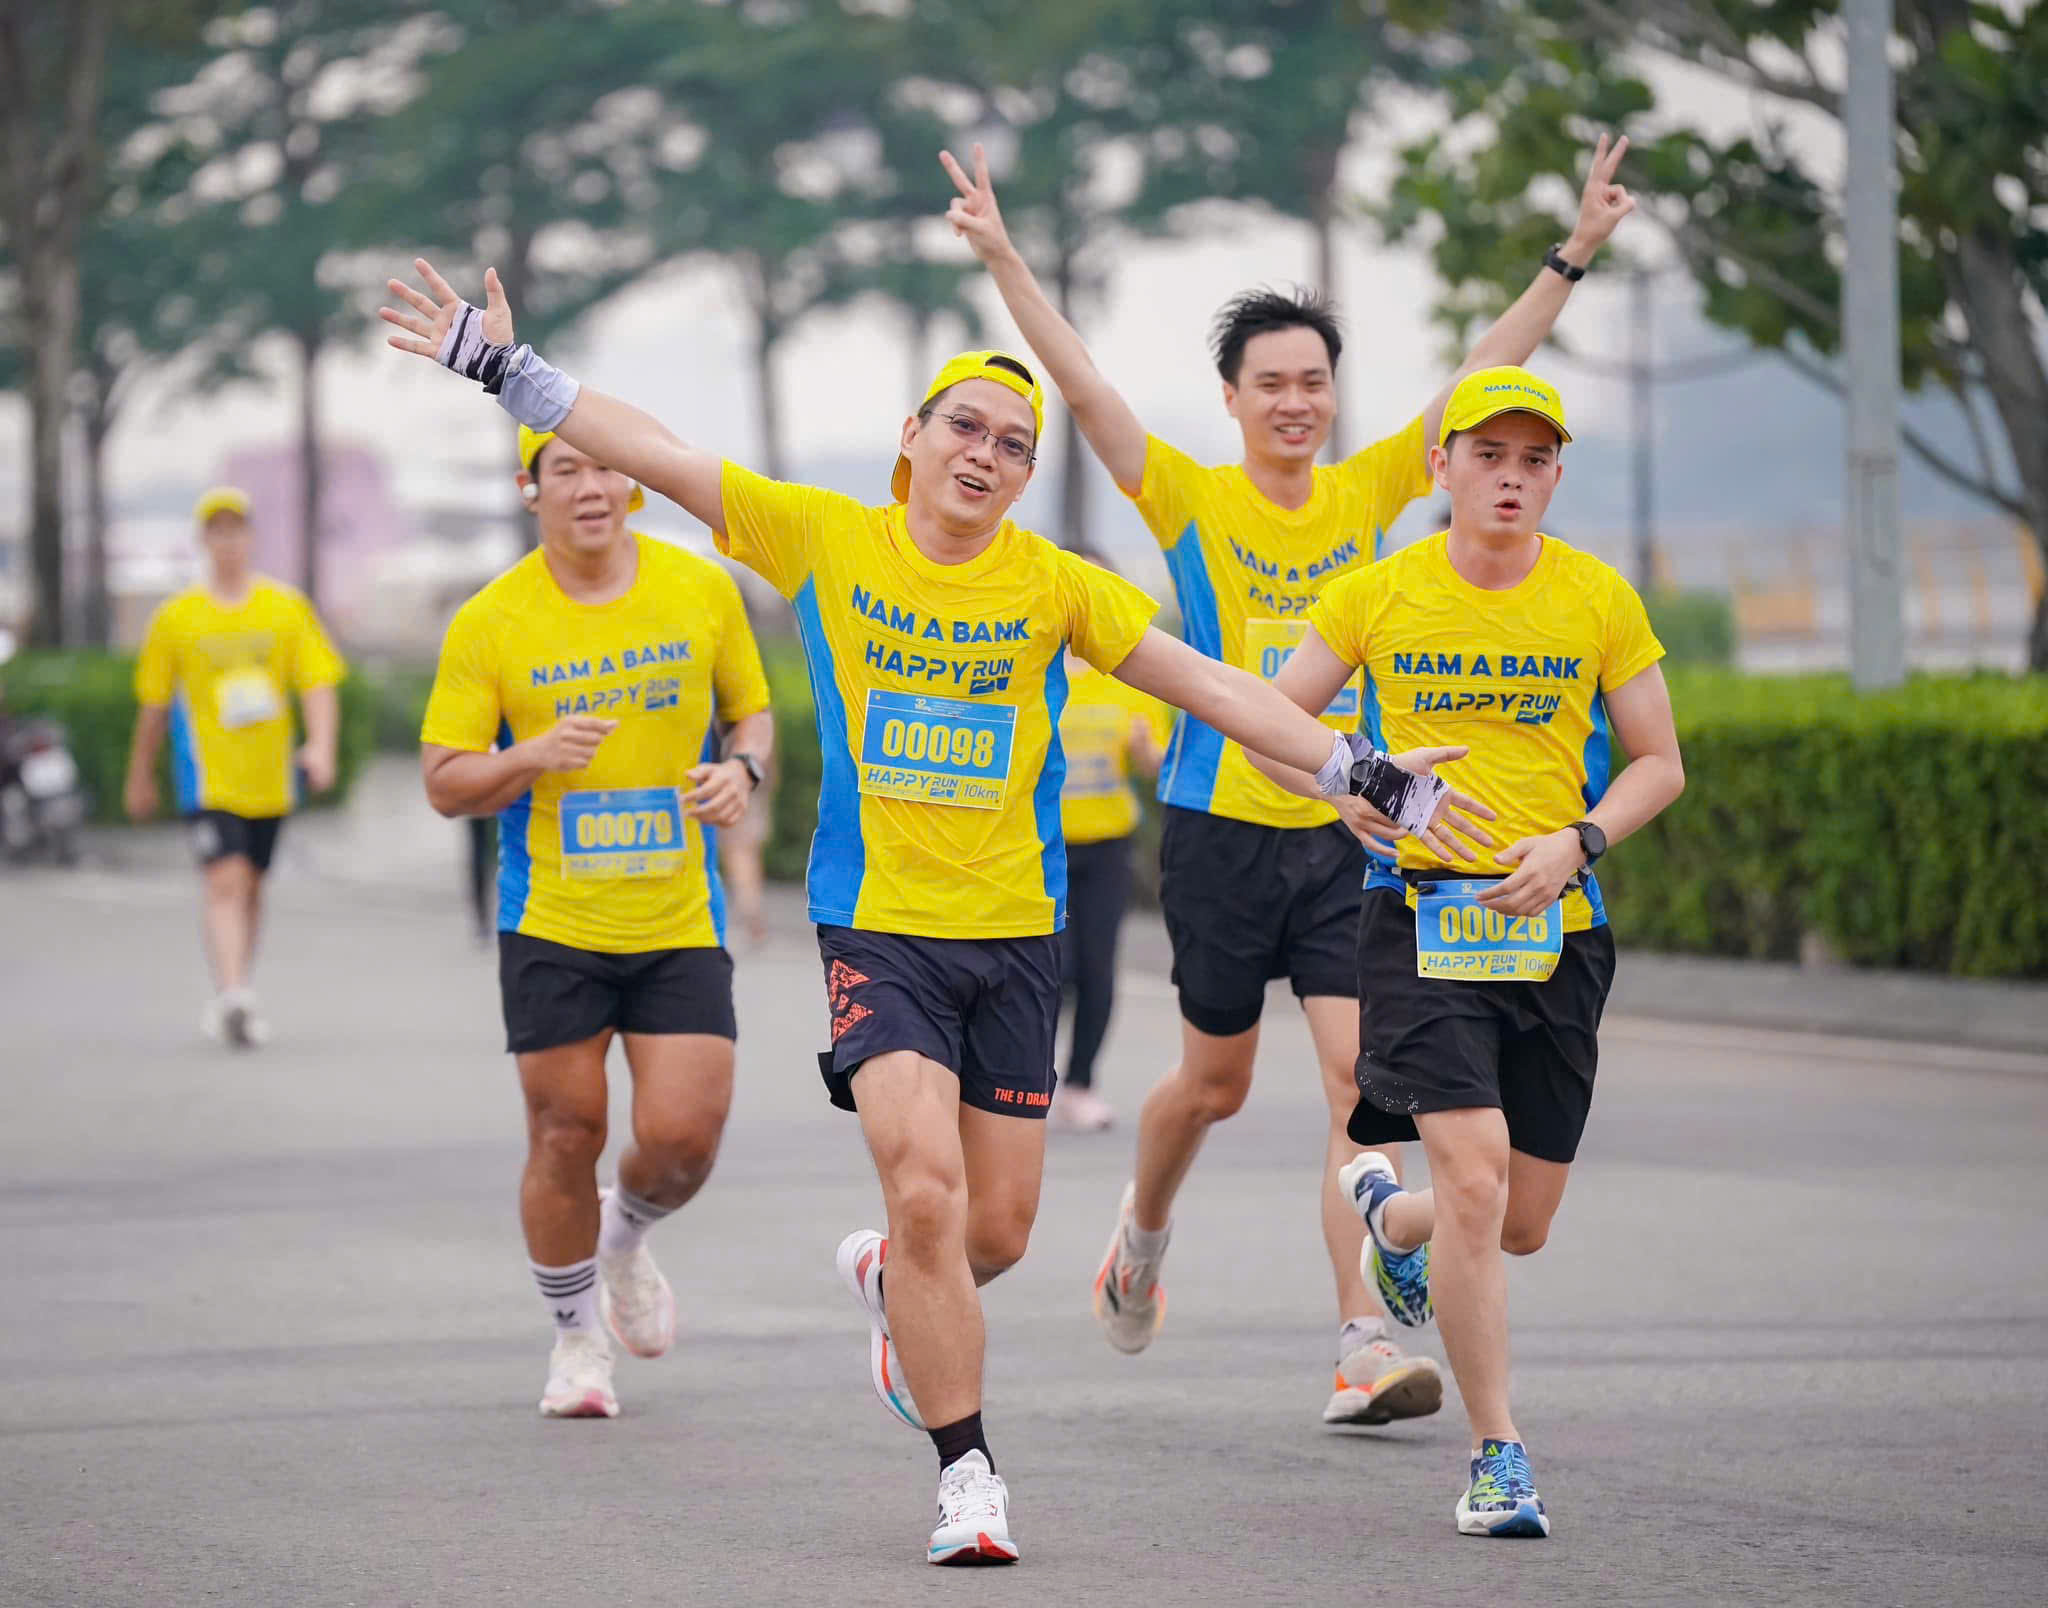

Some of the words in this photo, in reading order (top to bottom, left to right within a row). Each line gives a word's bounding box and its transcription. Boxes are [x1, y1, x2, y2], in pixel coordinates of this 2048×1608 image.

[1484, 384, 1512, 393] NAM
[1287, 568, 1300, 582] A
[1308, 536, 1359, 579] BANK
[852, 583, 915, 636] NAM
[922, 618, 944, 642] A
[952, 617, 1032, 644] BANK
[531, 659, 591, 688] NAM
[600, 656, 616, 675] A
[623, 640, 693, 670] BANK
[865, 640, 970, 685] HAPPY
[972, 657, 1015, 678] RUN
[1393, 652, 1462, 676] NAM
[1470, 653, 1493, 677] A
[1500, 655, 1582, 680] BANK
[555, 682, 641, 718] HAPPY
[1414, 691, 1518, 713] HAPPY
[1519, 693, 1561, 711] RUN
[881, 718, 996, 769] 00098
[867, 768, 930, 790] HAPPY
[932, 776, 959, 788] RUN
[964, 783, 999, 799] 10km
[576, 809, 673, 848] 00079
[1439, 905, 1548, 944] 00026
[1427, 954, 1490, 969] HAPPY
[1490, 954, 1518, 965] RUN
[995, 1088, 1014, 1103] THE
[1017, 1091, 1024, 1104] 9
